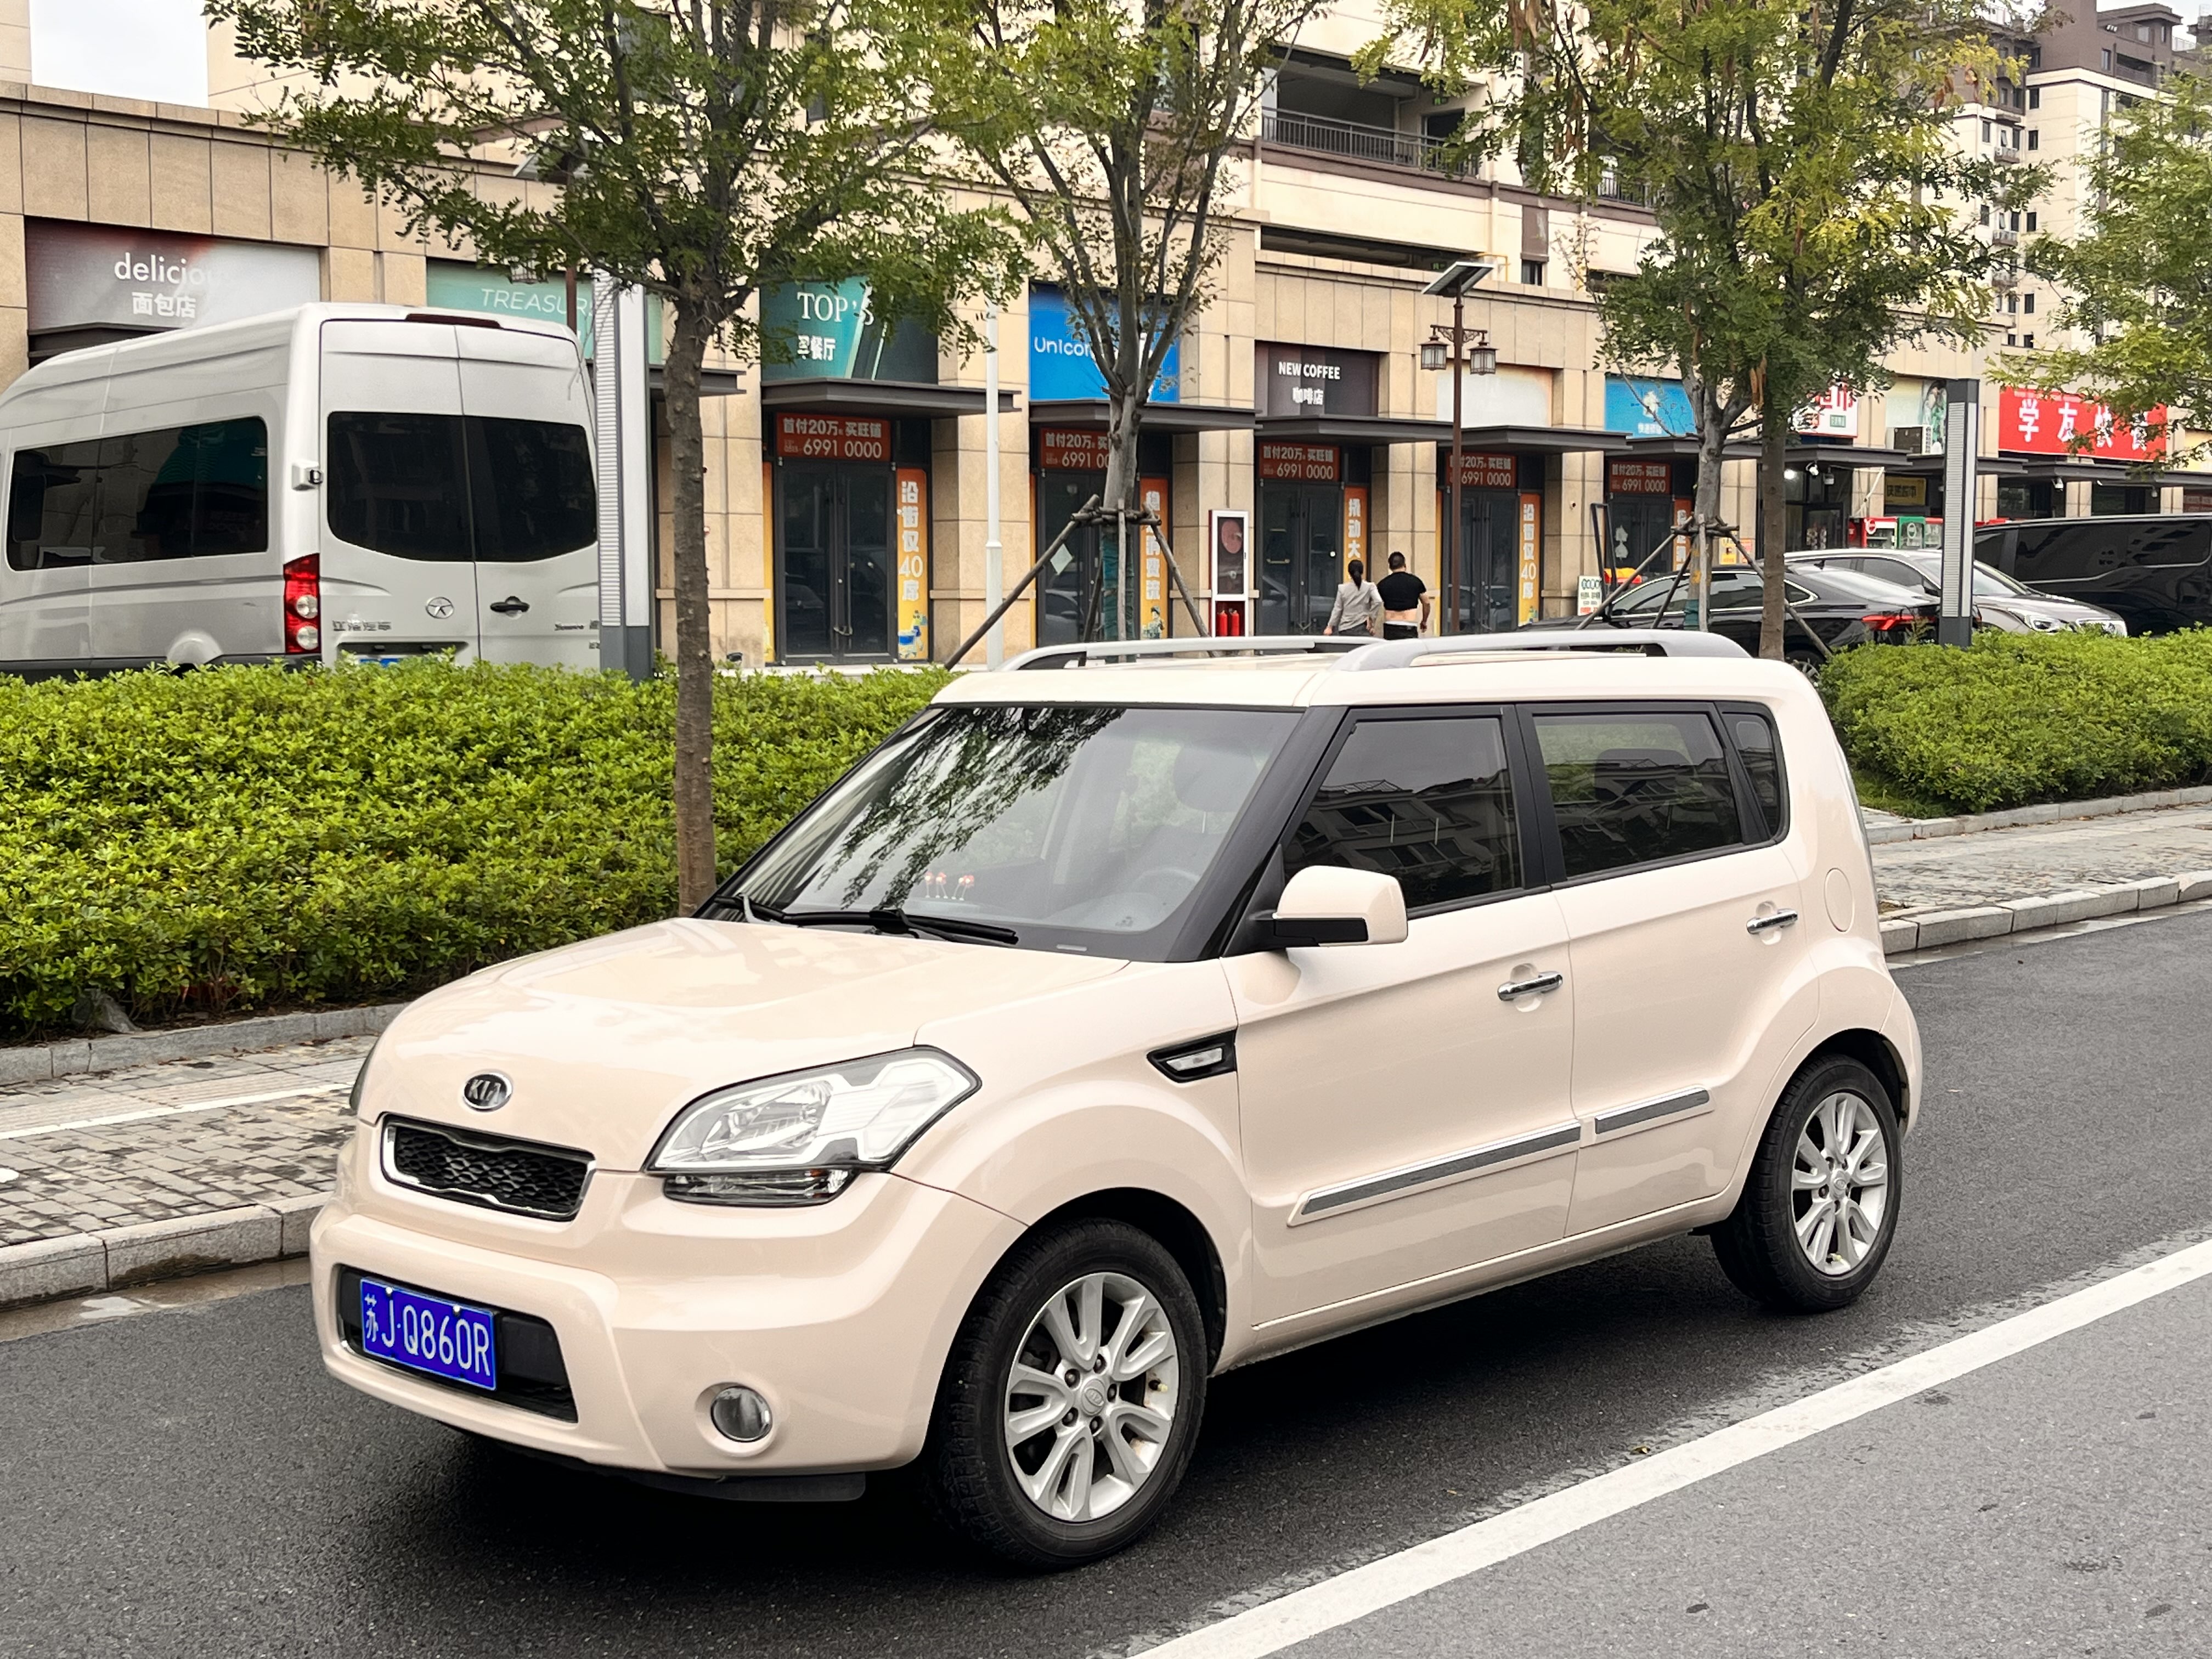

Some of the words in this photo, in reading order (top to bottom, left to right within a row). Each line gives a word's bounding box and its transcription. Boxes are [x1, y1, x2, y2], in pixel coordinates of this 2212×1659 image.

[132, 292, 196, 318] 面包店
[482, 289, 592, 317] TREASUR
[797, 335, 836, 361] 早餐厅
[1279, 362, 1302, 376] NEW
[1304, 364, 1340, 380] COFFEE
[1293, 386, 1324, 405] 咖啡店
[803, 438, 843, 456] 6991
[844, 441, 882, 459] 0000
[1062, 452, 1091, 468] 6991
[1277, 463, 1301, 478] 6991
[1306, 465, 1333, 479] 0000
[1462, 471, 1483, 484] 6991
[1487, 472, 1511, 486] 0000
[1622, 479, 1641, 491] 6991
[1645, 479, 1666, 493] 0000
[467, 1079, 501, 1104] KIA
